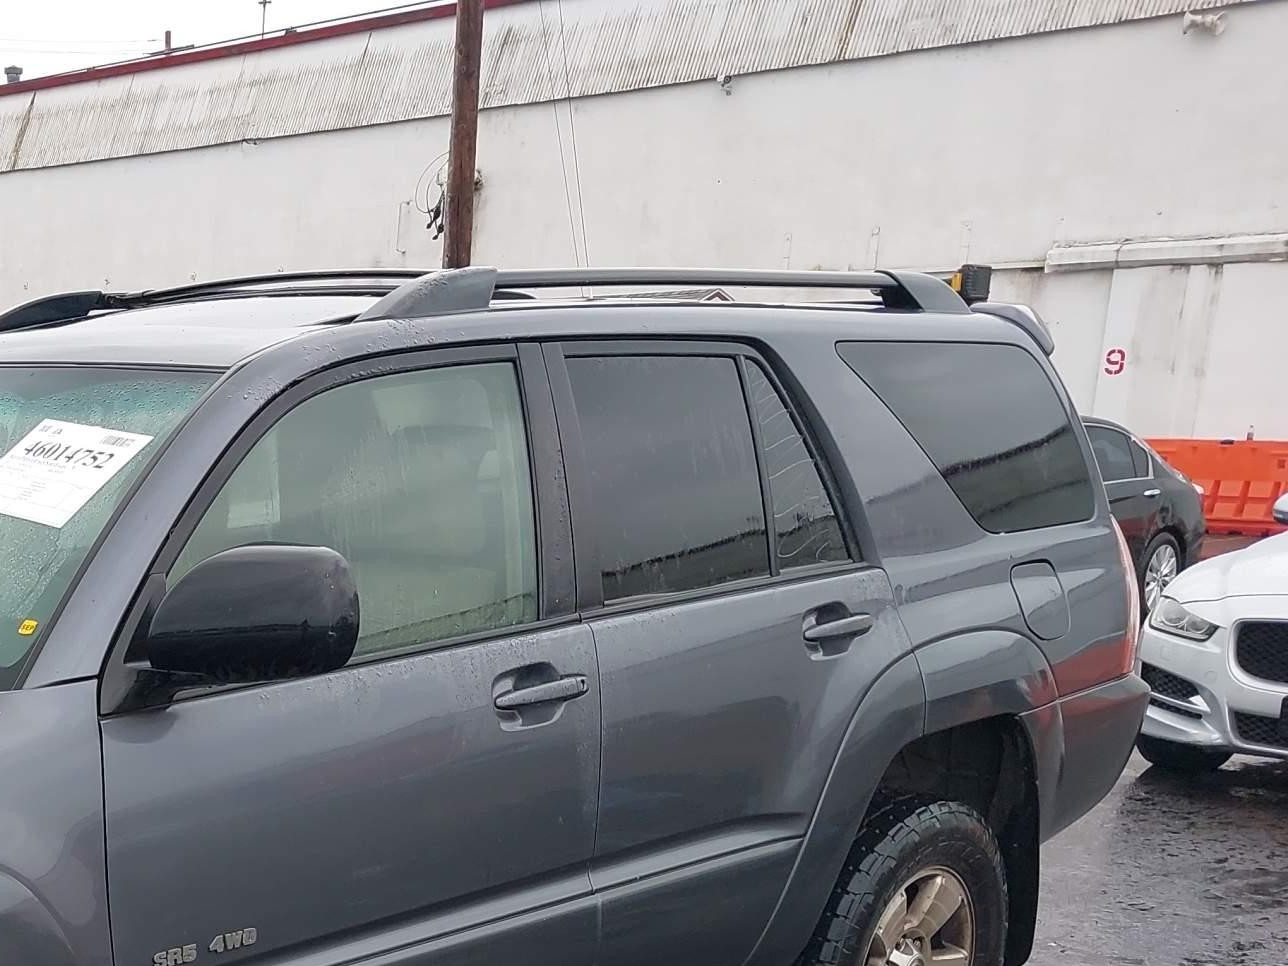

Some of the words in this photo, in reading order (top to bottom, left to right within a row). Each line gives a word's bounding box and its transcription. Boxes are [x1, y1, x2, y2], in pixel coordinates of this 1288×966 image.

[1104, 348, 1126, 376] 9
[24, 441, 115, 469] 46014752
[208, 927, 257, 954] 4WD
